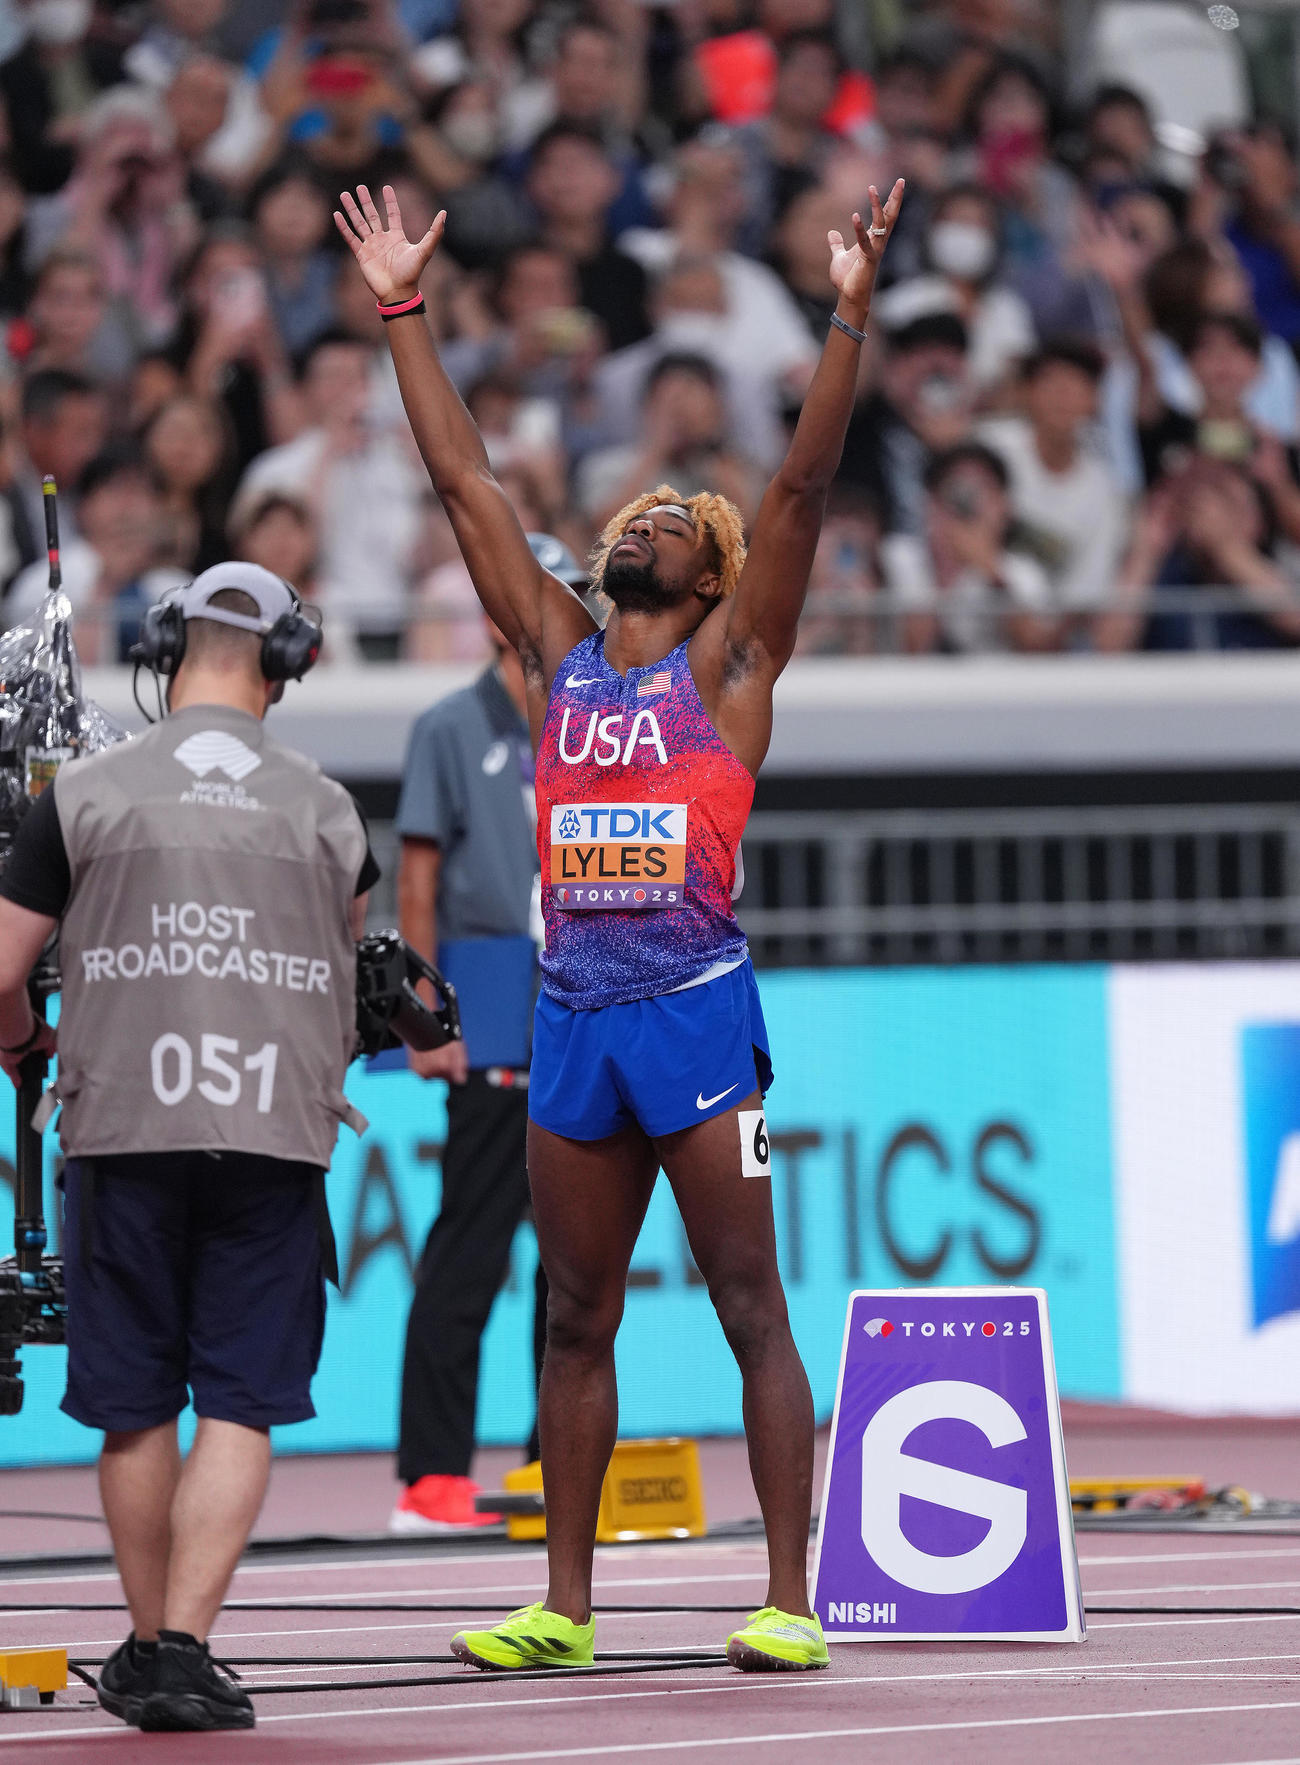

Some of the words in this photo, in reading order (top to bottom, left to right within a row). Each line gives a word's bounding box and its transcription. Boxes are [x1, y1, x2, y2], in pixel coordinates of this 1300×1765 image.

[558, 707, 669, 767] USA
[580, 809, 675, 839] TDK
[562, 846, 667, 878] LYLES
[152, 902, 255, 942] HOST
[151, 1032, 279, 1113] 051
[754, 1117, 769, 1165] 6
[861, 1380, 1028, 1594] 6
[828, 1602, 896, 1624] NISHI
